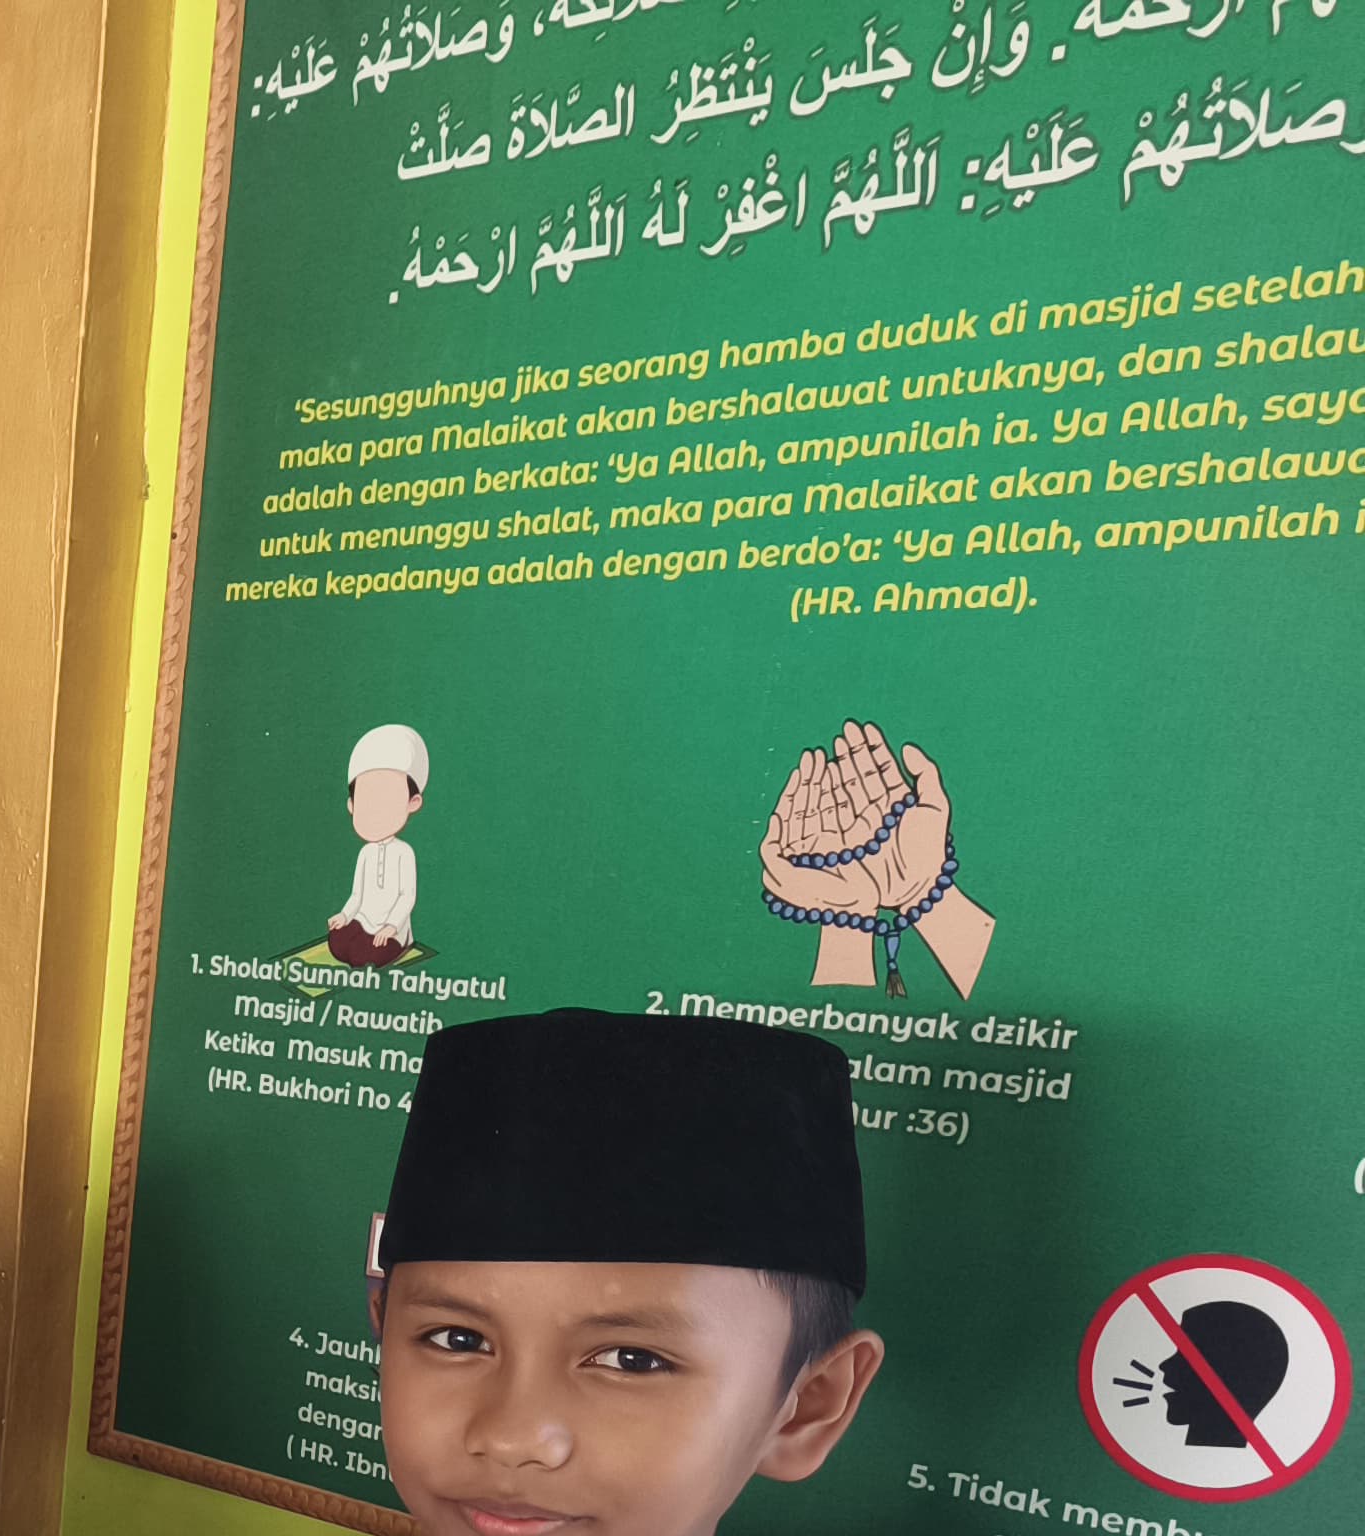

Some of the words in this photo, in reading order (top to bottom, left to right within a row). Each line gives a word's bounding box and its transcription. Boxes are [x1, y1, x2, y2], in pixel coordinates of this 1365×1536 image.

[509, 365, 570, 404] jika
[577, 348, 710, 388] seorang
[719, 328, 846, 369] hamba
[856, 308, 979, 353] duduk
[989, 298, 1029, 337] di
[1038, 281, 1183, 331] masjid
[1193, 260, 1365, 313] setelah
[279, 439, 353, 470] maka
[359, 434, 424, 467] para
[431, 412, 569, 453] Malaikat
[575, 404, 657, 436] akan
[665, 375, 892, 426] bershalawat
[901, 355, 1106, 401] untuknya,
[1117, 342, 1202, 378] dan
[262, 481, 353, 515] adalah
[359, 475, 466, 507] dengan
[473, 460, 600, 495] berkata:
[667, 439, 767, 476] Allah,
[776, 416, 982, 467] ampunilah
[992, 411, 1039, 446] ia.
[1052, 407, 1109, 444] Ya
[1120, 392, 1249, 434] Allah,
[259, 527, 333, 558] untuk
[339, 519, 490, 551] menunggu
[496, 506, 600, 539] shalat,
[609, 496, 703, 529] maka
[711, 492, 794, 528] para
[803, 473, 980, 514] Malaikat
[989, 465, 1093, 501] akan
[225, 573, 319, 602] mereka
[324, 564, 480, 600] kepadanya
[487, 551, 594, 586] adalah
[602, 548, 728, 582] dengan
[965, 518, 1083, 556] Allah,
[1094, 502, 1340, 552] ampunilah
[790, 585, 862, 624] (HR.
[872, 575, 1038, 615] Ahmad).
[190, 953, 204, 975] 1.
[210, 954, 283, 981] Sholat
[288, 961, 380, 990] Sunnah
[388, 969, 507, 1001] Tahyatul
[234, 994, 316, 1026] Masjid
[319, 999, 333, 1027] /
[336, 1004, 444, 1036] Rawatib
[644, 990, 670, 1016] 2.
[679, 993, 960, 1043] Memperbanyak
[970, 1015, 1078, 1050] dzikir
[204, 1028, 275, 1058] Ketika
[287, 1038, 373, 1069] Masuk
[208, 1065, 252, 1093] (HR.
[258, 1073, 352, 1105] Bukhori
[943, 1067, 1072, 1103] masjid
[906, 1108, 970, 1145] :36)
[289, 1327, 309, 1349] 4.
[306, 1370, 382, 1402] maksi
[345, 1451, 394, 1483] Ibn
[907, 1463, 935, 1492] 5.
[947, 1472, 1051, 1518] Tidak
